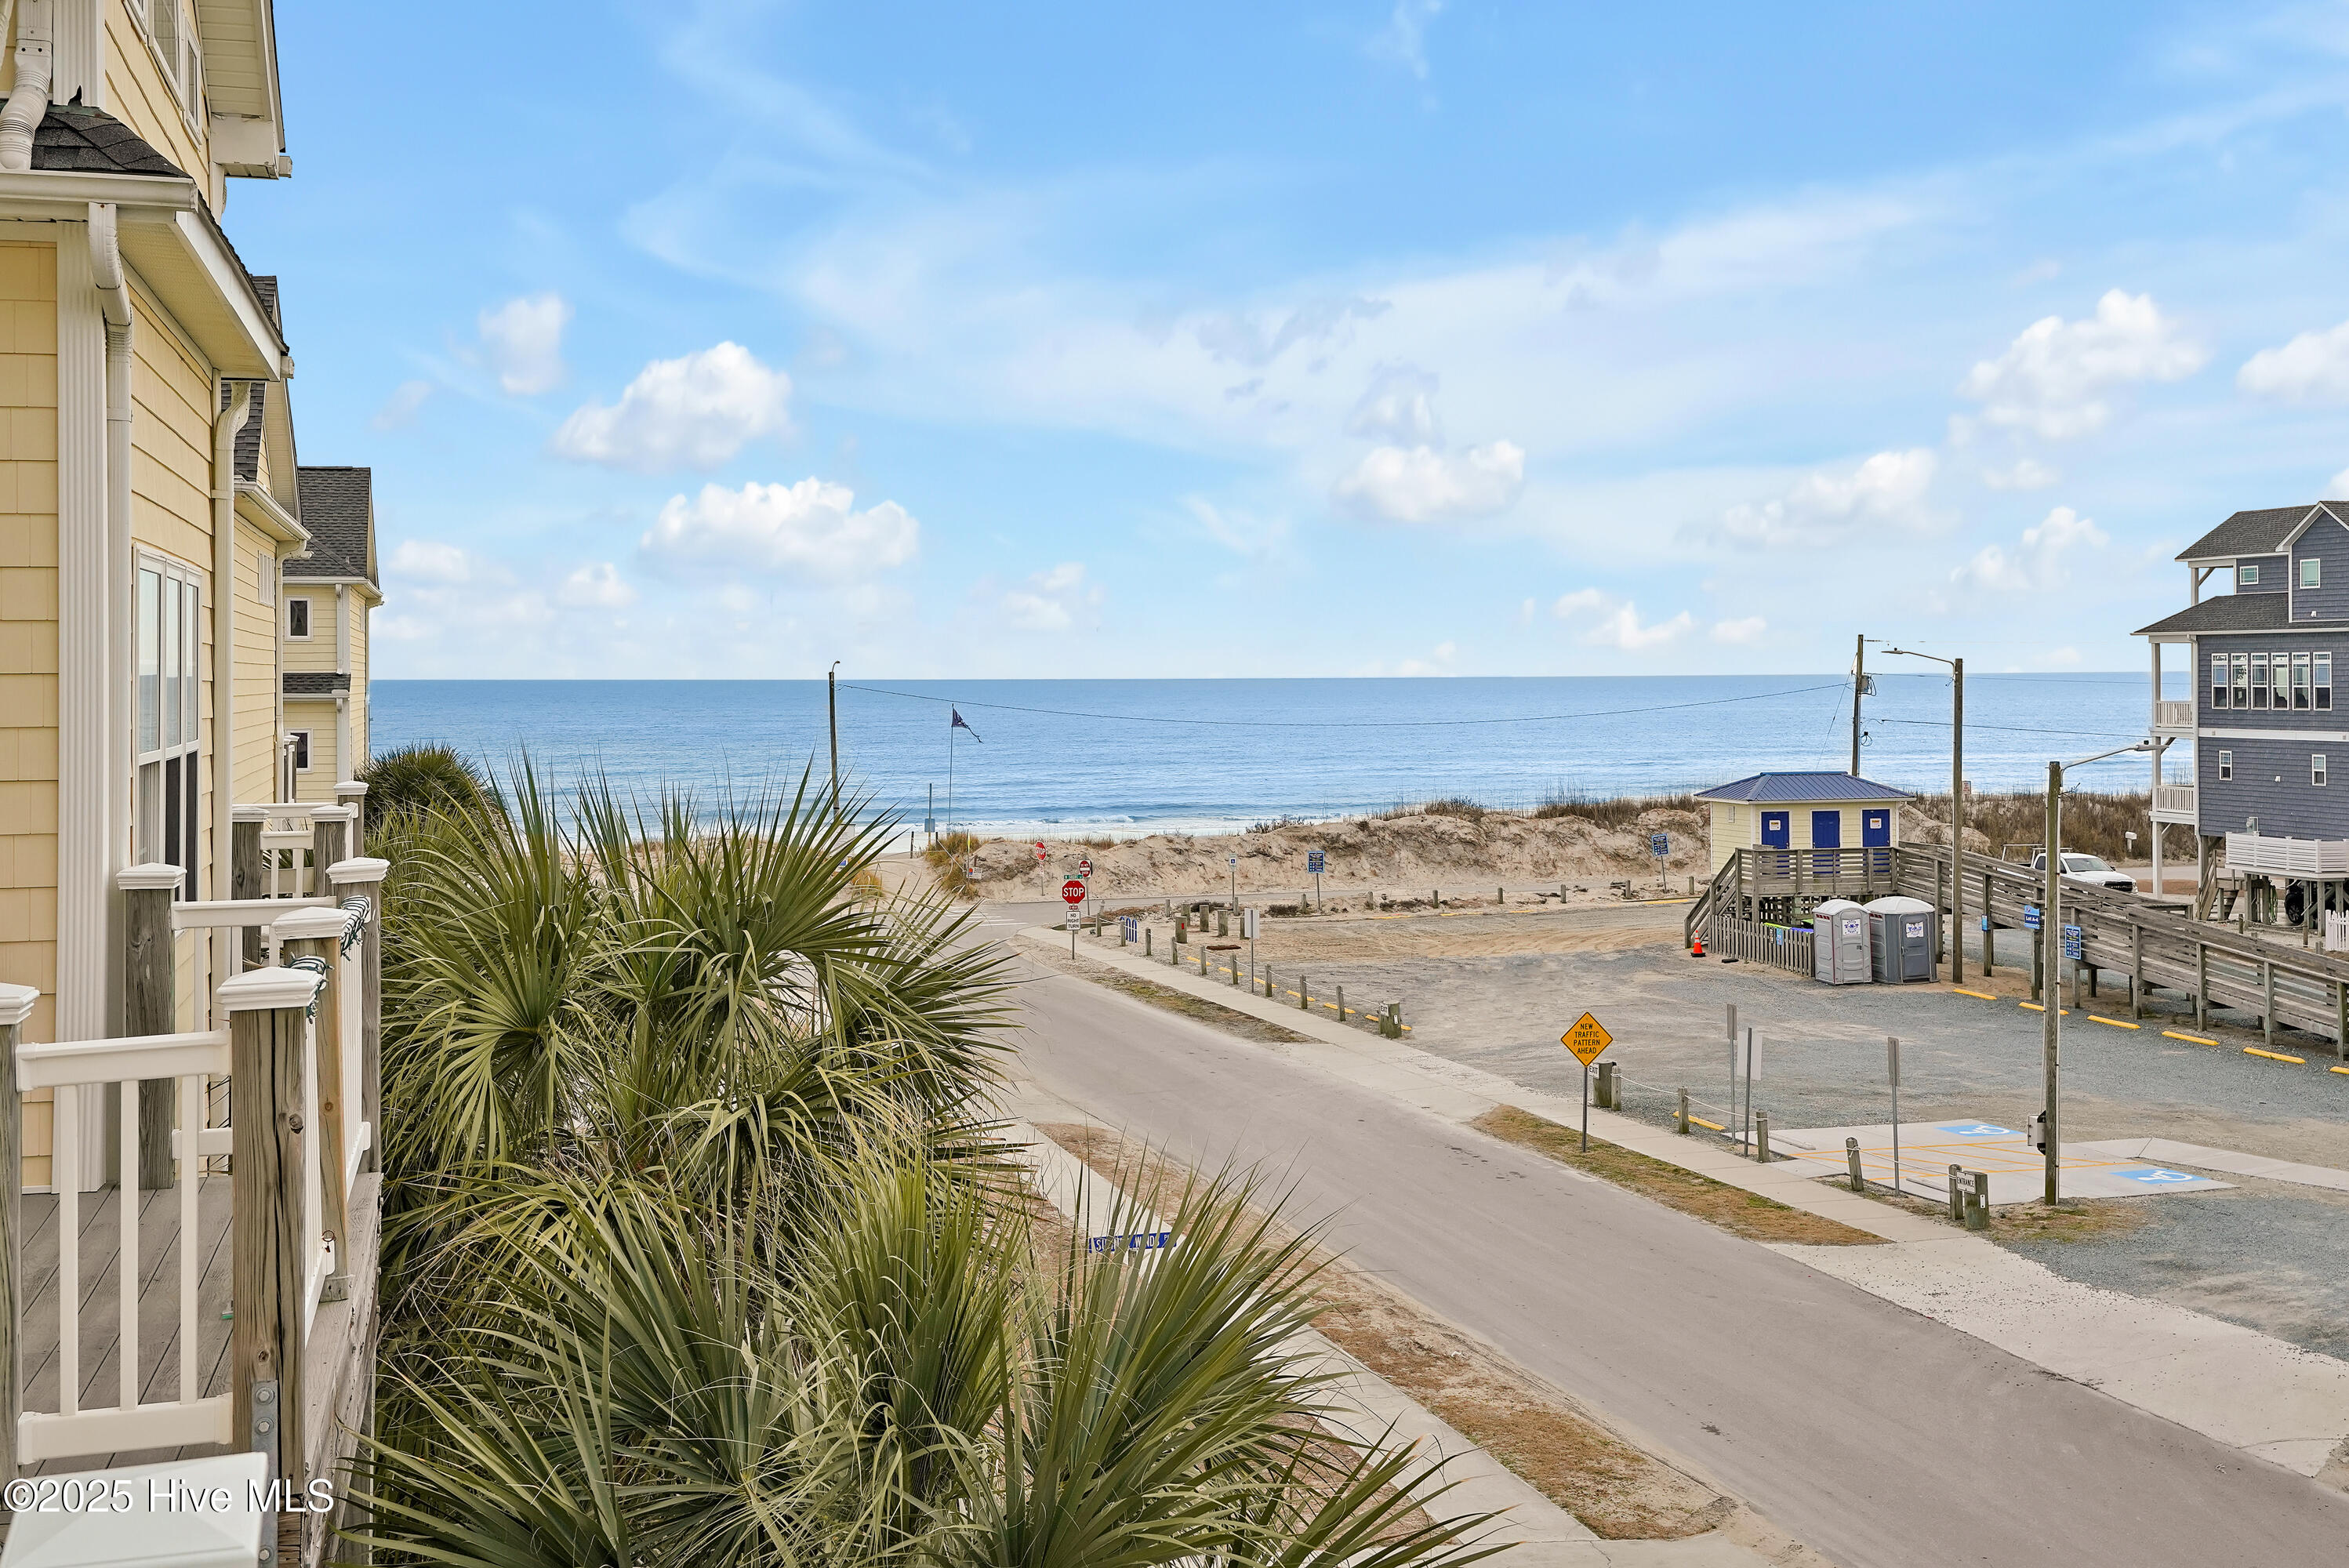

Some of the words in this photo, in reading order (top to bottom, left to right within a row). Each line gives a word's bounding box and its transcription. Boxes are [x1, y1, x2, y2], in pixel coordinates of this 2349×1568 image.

[1035, 847, 1046, 855] STOP
[1063, 887, 1084, 897] STOP
[1588, 1065, 1599, 1075] EXIT
[1957, 1176, 1974, 1188] ENTRANCE
